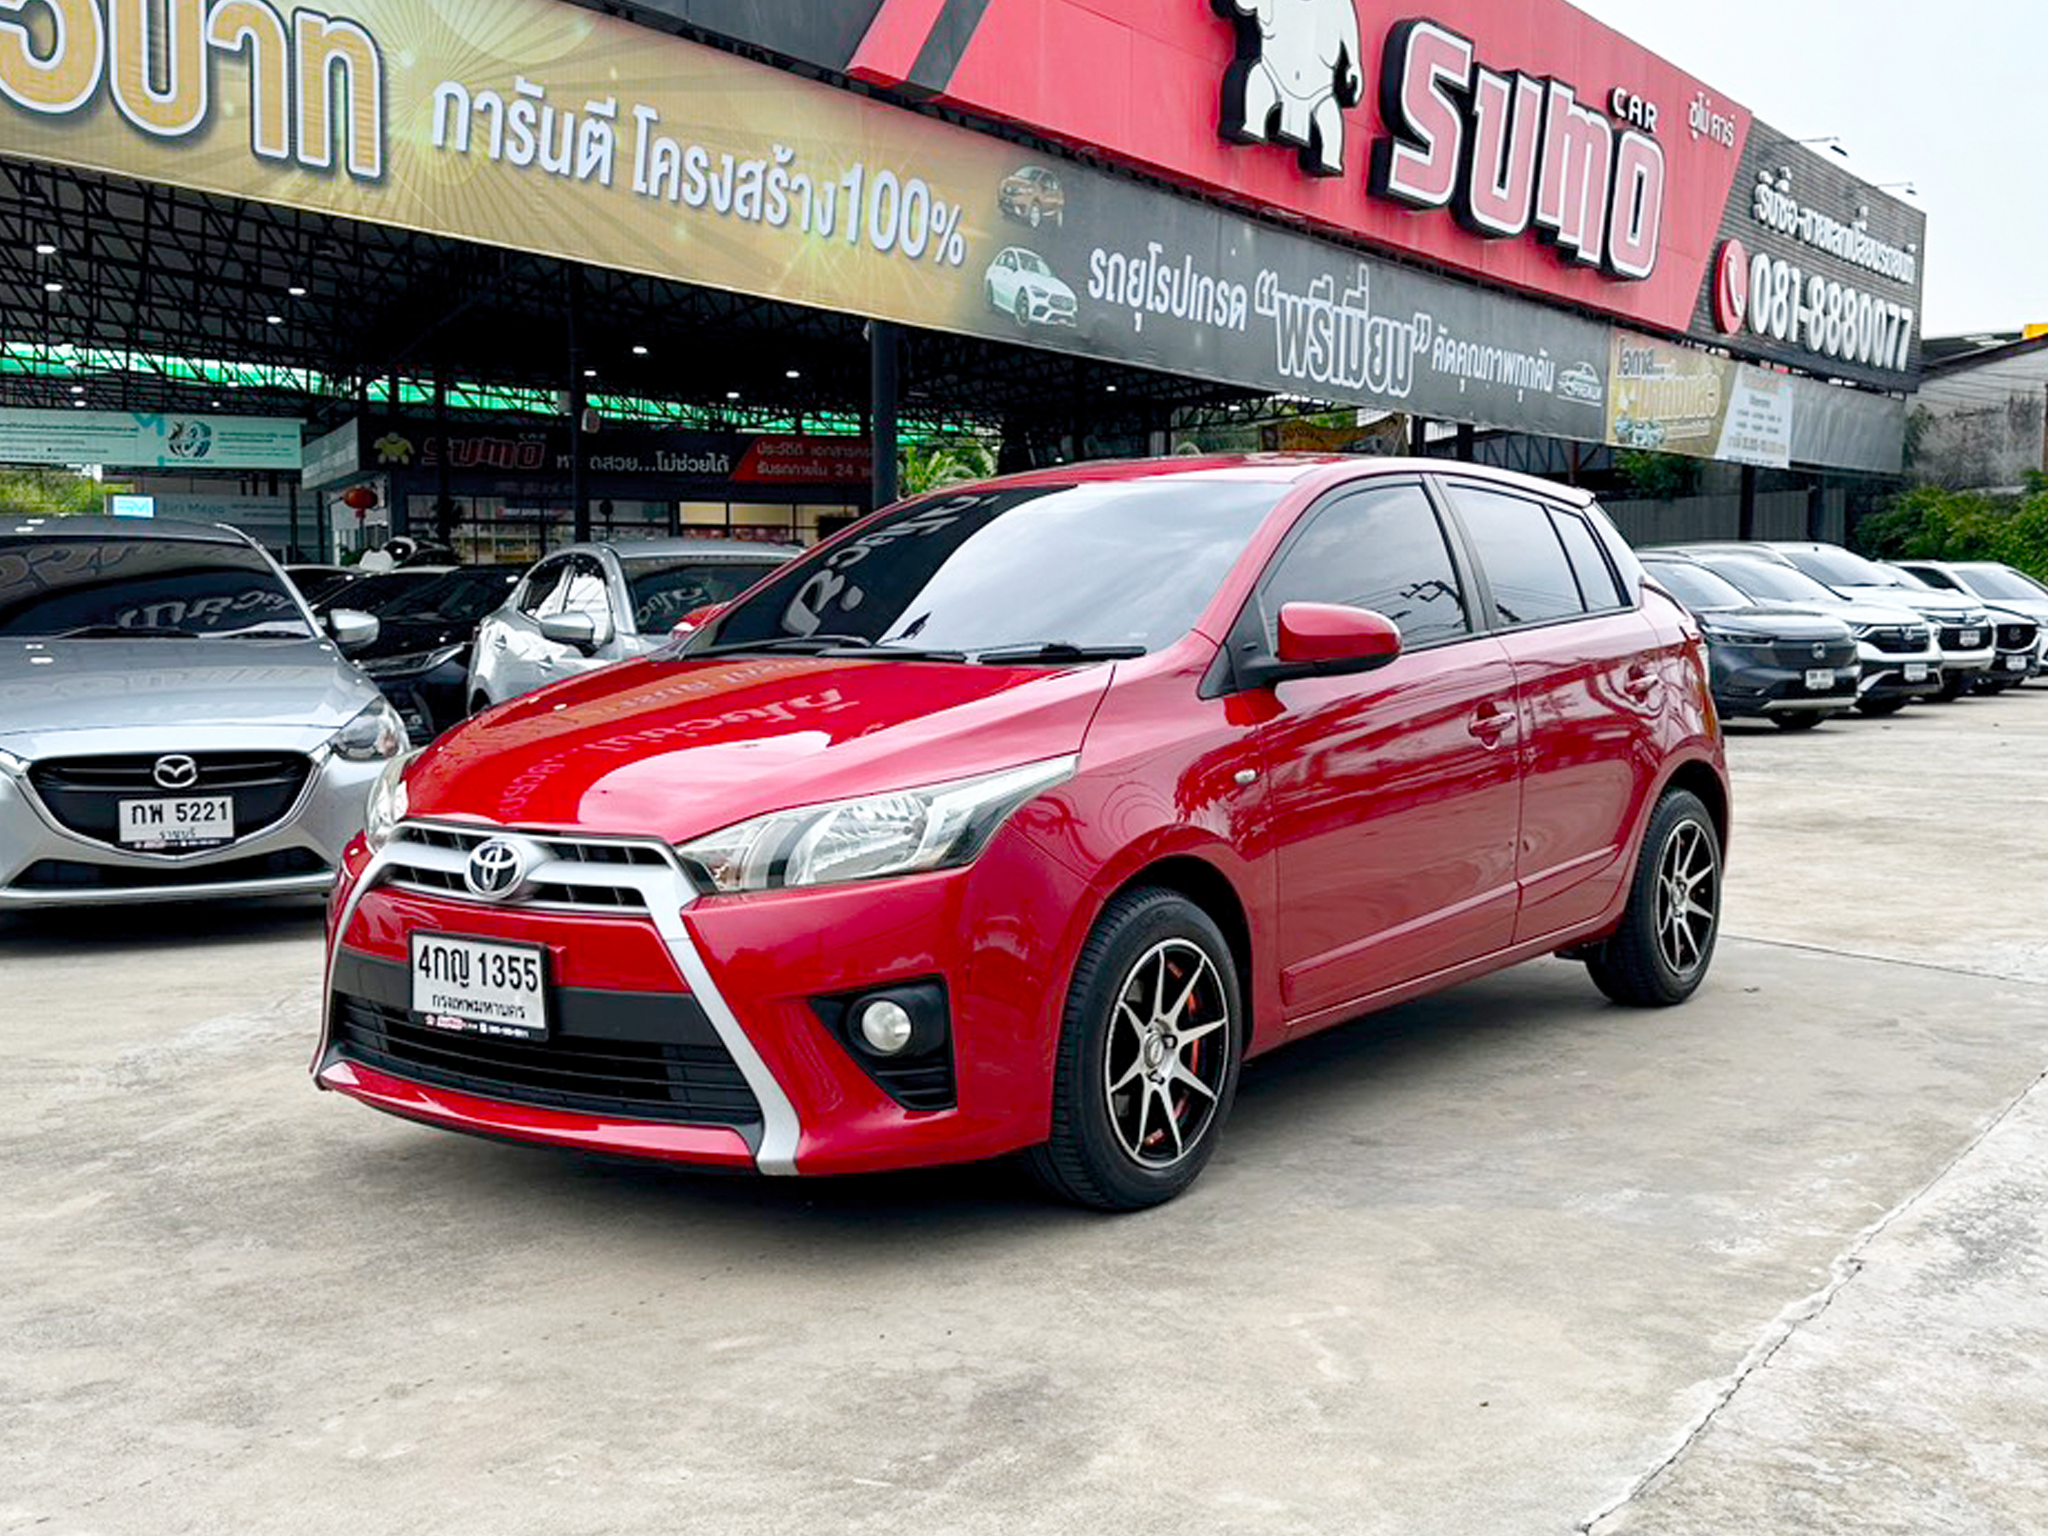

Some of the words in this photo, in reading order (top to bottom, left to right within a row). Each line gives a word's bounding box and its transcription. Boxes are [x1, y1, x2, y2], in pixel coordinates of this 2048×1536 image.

[1612, 86, 1658, 134] CAR
[433, 74, 617, 185] การันตี
[632, 103, 966, 266] โครงสร้าง100%
[1087, 241, 1248, 333] รถยุโรปเกรด
[1431, 323, 1556, 403] คัดคุณภาพทุกคัน
[1750, 252, 1914, 373] 081-8880077
[174, 800, 228, 823] 5221
[418, 944, 471, 989] 4กญ
[478, 951, 538, 993] 1355
